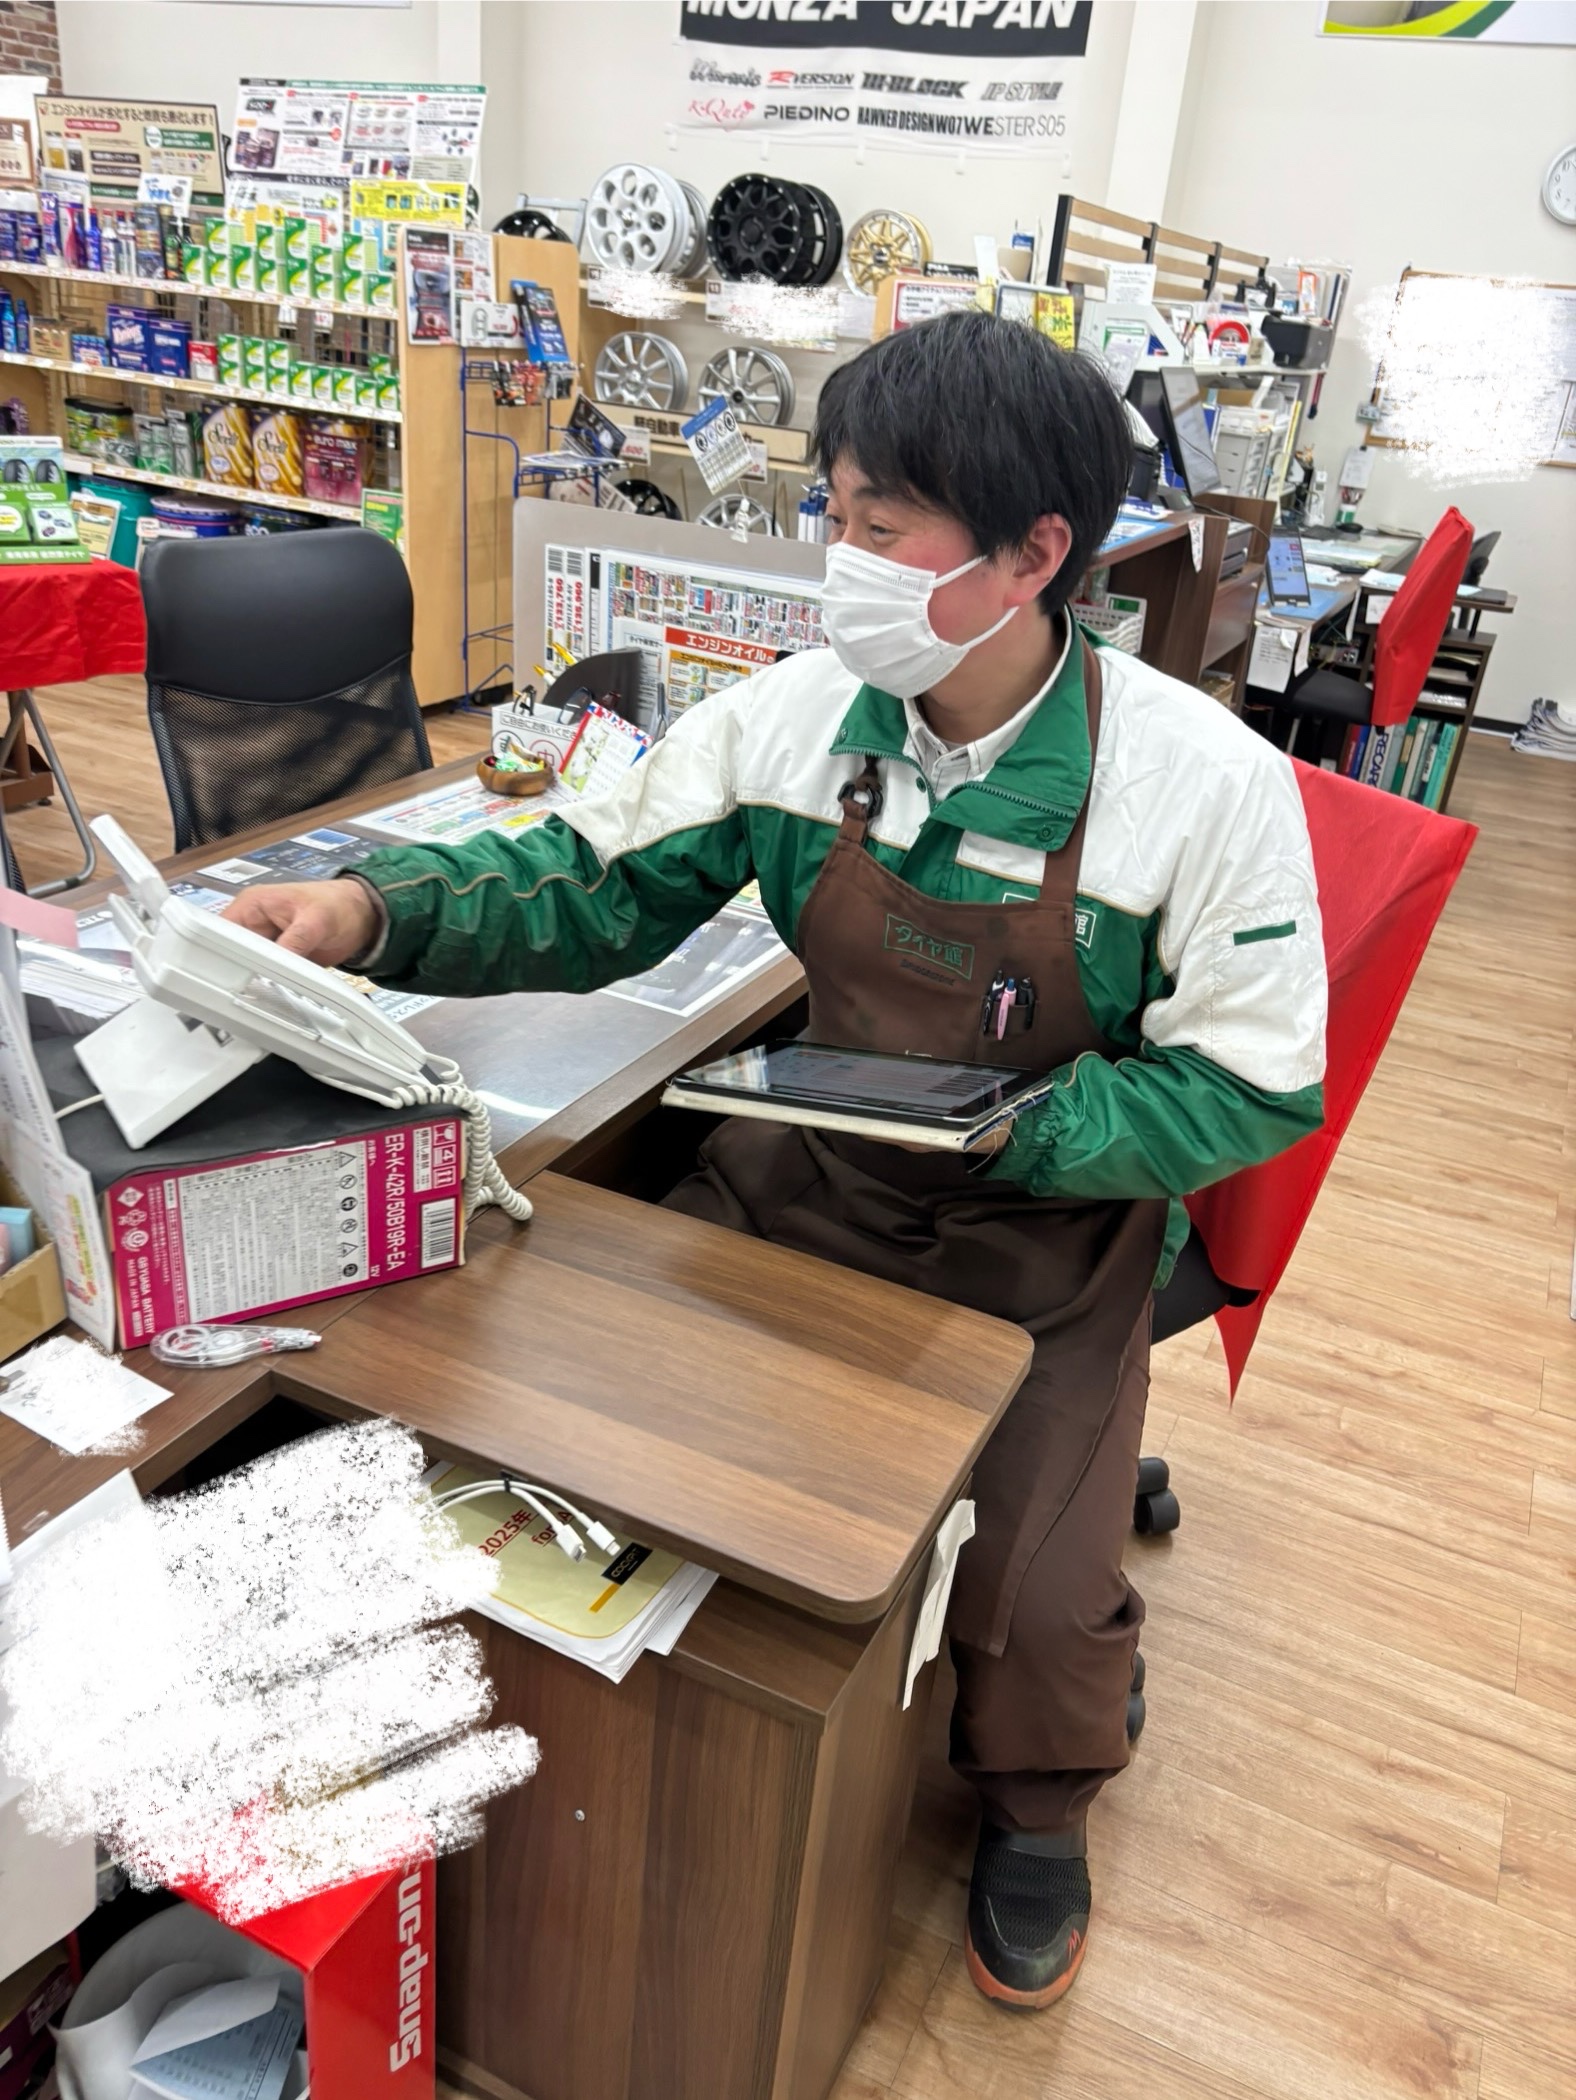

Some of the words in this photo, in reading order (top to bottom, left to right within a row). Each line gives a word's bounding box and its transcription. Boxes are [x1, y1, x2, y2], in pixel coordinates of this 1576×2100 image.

[891, 0, 1077, 30] JAPAN
[764, 104, 850, 122] PIEDINO
[898, 110, 935, 133] DESIGN
[1036, 117, 1067, 136] S05
[894, 924, 964, 968] タイヤ館
[385, 1133, 405, 1272] ER-K-42R/50B19R-EA
[141, 1297, 155, 1334] BATTERY
